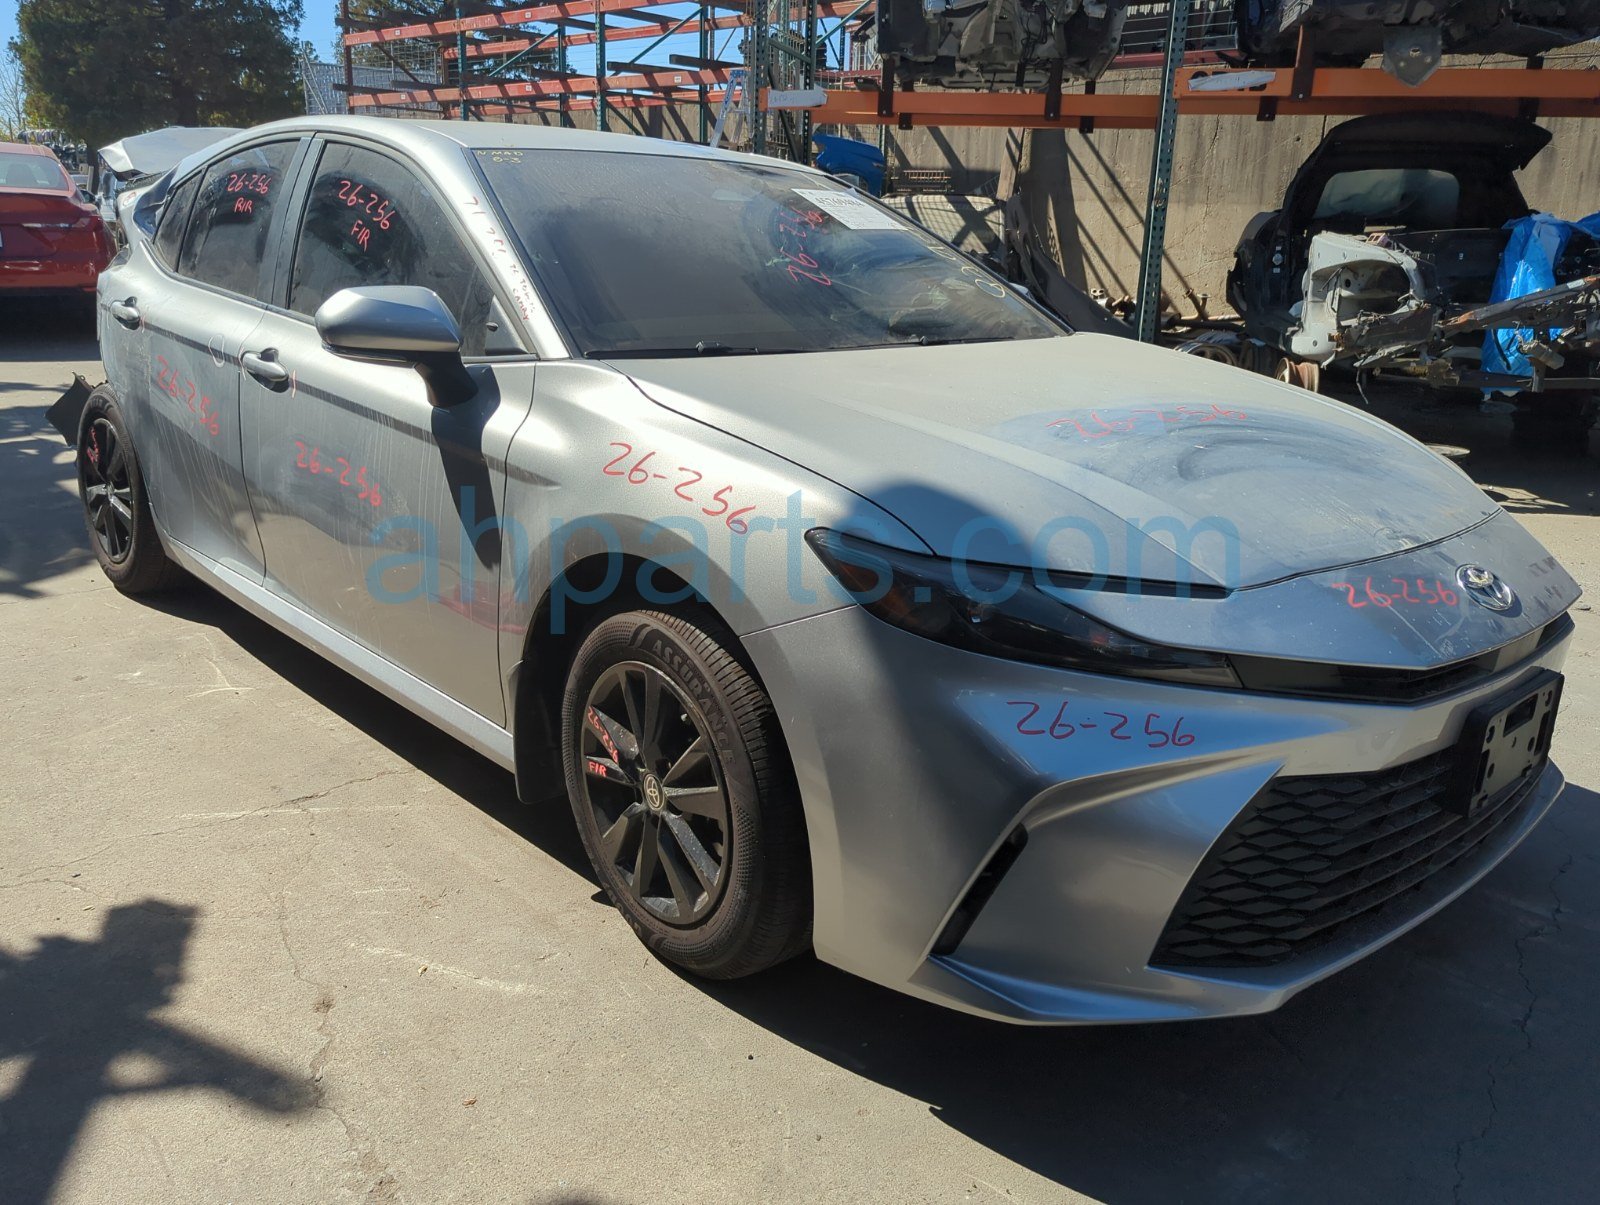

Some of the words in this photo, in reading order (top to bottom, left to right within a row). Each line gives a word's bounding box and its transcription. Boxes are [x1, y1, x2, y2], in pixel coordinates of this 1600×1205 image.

[227, 173, 272, 195] 26-256
[338, 180, 396, 230] 26-256
[157, 355, 220, 436] 26-256
[294, 440, 383, 508] 26-256
[602, 442, 757, 535] 26-256
[1331, 575, 1460, 608] 26-256
[652, 639, 737, 765] ASSURANCE
[1006, 701, 1196, 748] 26-256
[587, 705, 619, 764] 26-256
